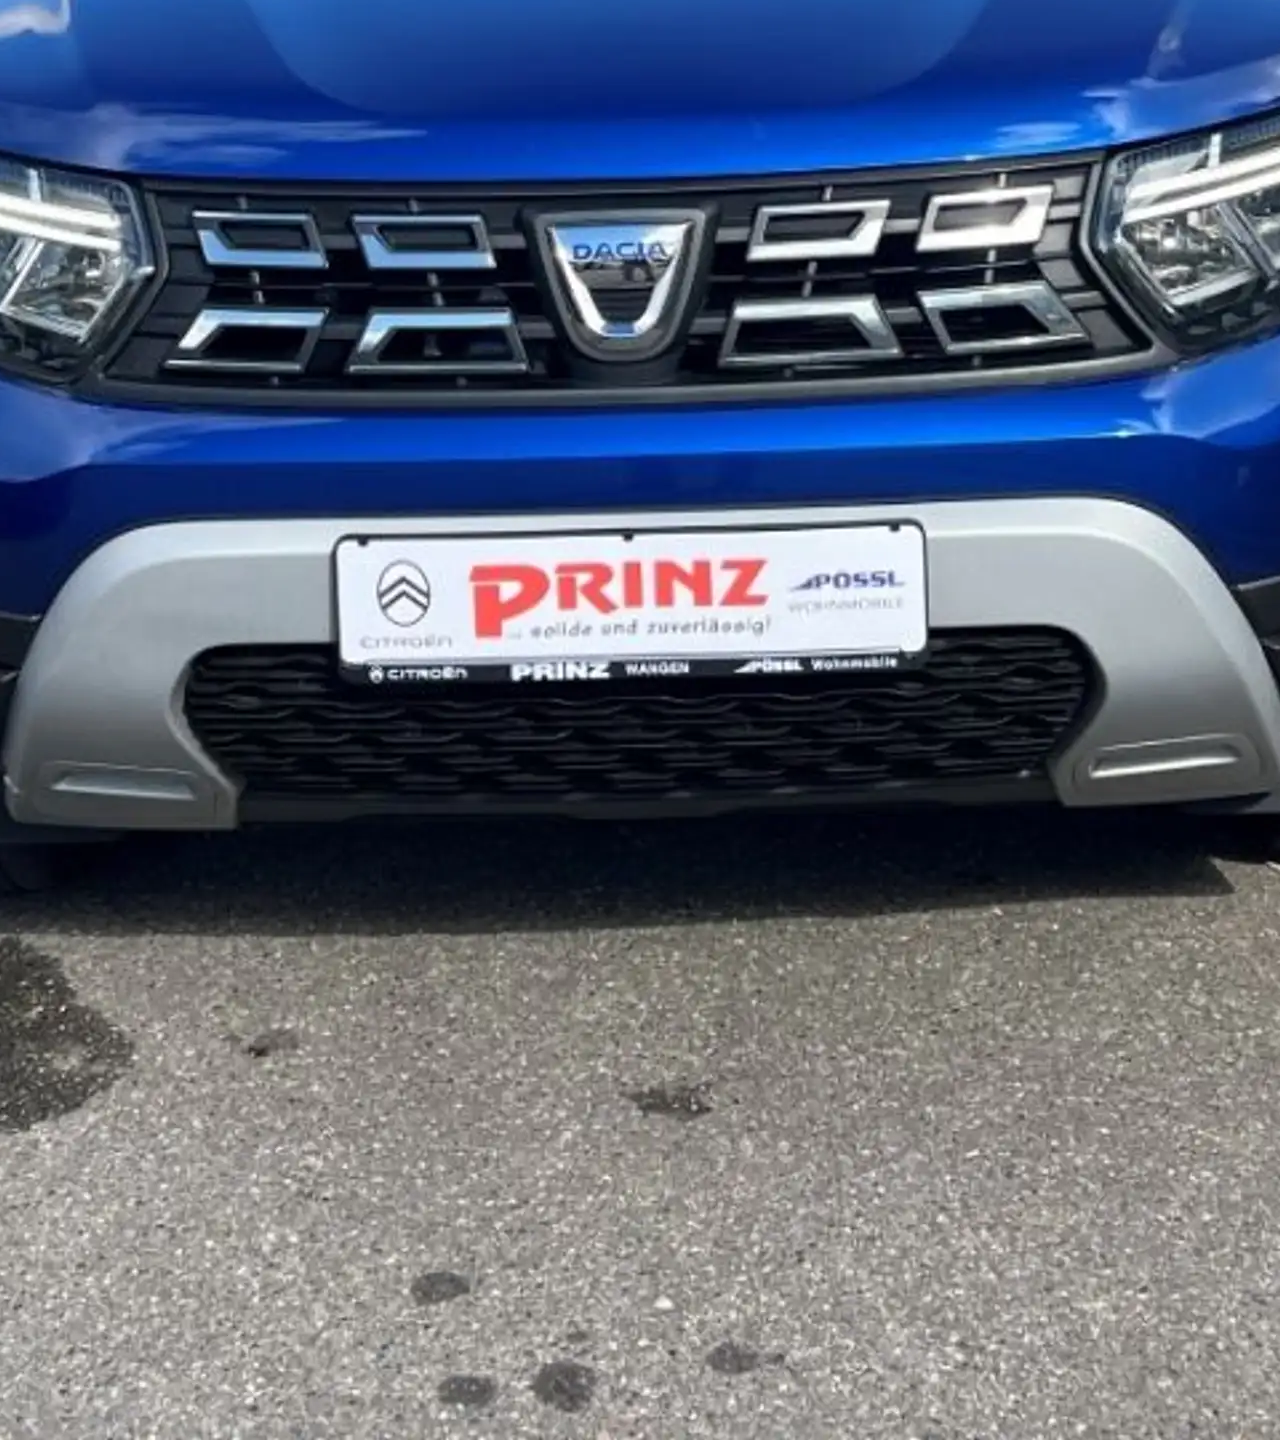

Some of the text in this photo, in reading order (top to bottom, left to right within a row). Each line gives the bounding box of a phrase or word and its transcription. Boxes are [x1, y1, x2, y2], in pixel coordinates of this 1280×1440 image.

[572, 242, 668, 261] DACIA
[470, 560, 769, 638] PRINZ
[530, 616, 772, 640] solide und zuverlässig!
[510, 661, 690, 682] PRINZ WANGEN
